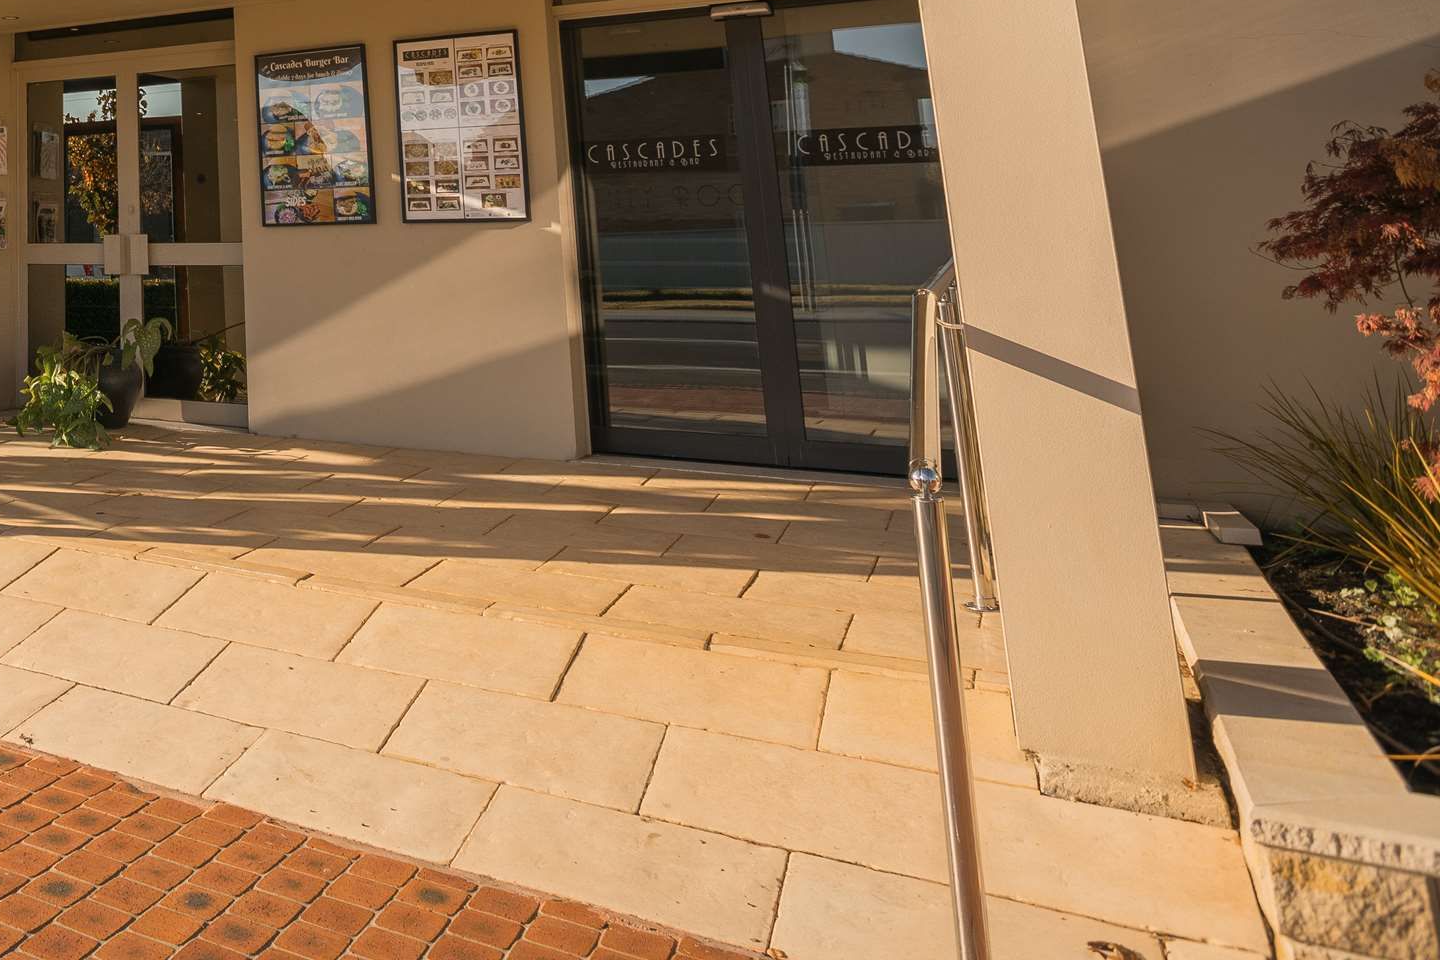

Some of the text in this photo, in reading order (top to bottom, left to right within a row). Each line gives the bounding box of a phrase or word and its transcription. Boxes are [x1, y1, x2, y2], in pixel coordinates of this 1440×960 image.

[270, 59, 303, 72] Cascades
[303, 57, 331, 68] Burger
[332, 55, 349, 65] Bar
[587, 138, 718, 164] CASCADES
[797, 129, 937, 155] CASCADE
